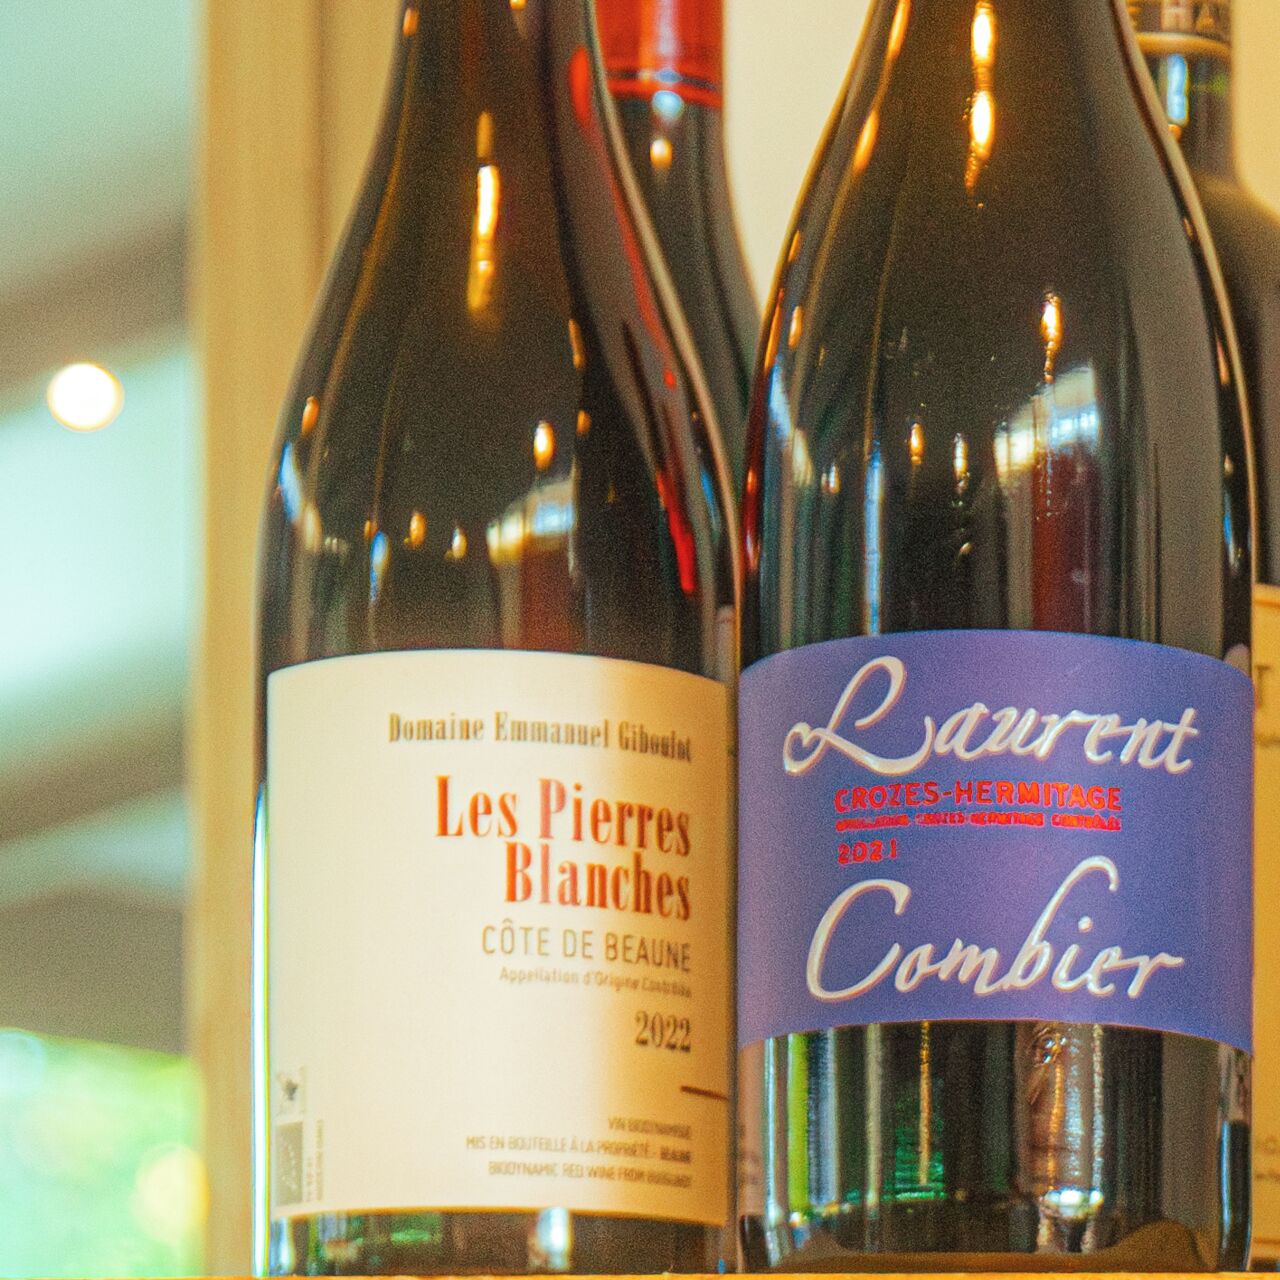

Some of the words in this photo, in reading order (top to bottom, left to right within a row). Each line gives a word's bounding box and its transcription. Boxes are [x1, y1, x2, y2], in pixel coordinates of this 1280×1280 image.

[388, 712, 485, 743] Domaine
[494, 711, 610, 748] Emmanuel
[618, 720, 693, 763] Giboulot
[782, 655, 1199, 776] Laurent
[434, 775, 518, 838] Les
[538, 777, 691, 857] Pierres
[833, 780, 1123, 813] CROZES-HERMITAGE
[837, 838, 897, 865] 2021
[504, 841, 691, 921] Blanches
[482, 917, 551, 957] CÔTE
[562, 928, 594, 960] DE
[604, 932, 692, 973] BEAUNE
[806, 856, 1185, 1002] Combier
[499, 965, 579, 985] Appellation
[635, 1010, 692, 1054] 2022
[465, 1134, 487, 1151] MIS
[489, 1135, 505, 1151] EN
